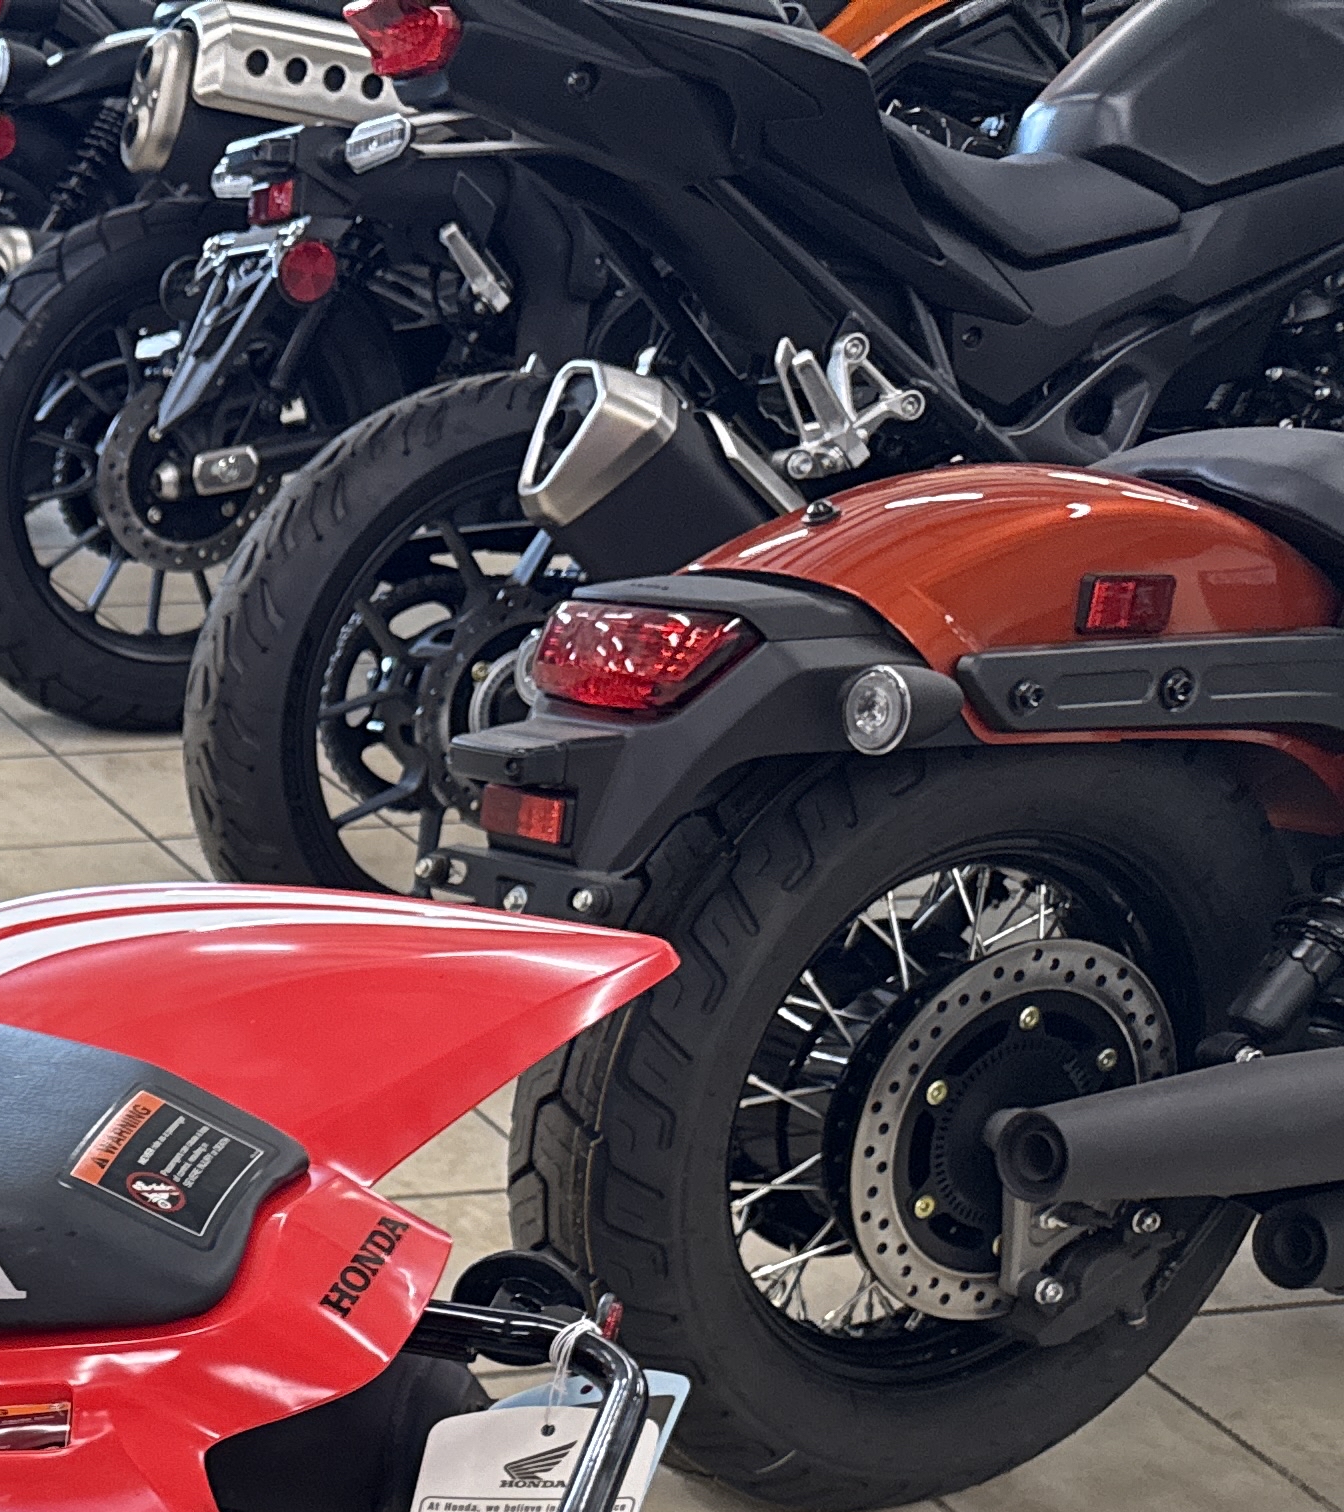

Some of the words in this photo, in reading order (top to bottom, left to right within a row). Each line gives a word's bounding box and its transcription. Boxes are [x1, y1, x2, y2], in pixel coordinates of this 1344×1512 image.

[102, 1104, 151, 1155] WARNING
[319, 1217, 410, 1319] HONDA
[499, 1480, 567, 1488] HONDA
[427, 1502, 440, 1511] At
[504, 1504, 542, 1512] believe
[546, 1504, 556, 1512] in
